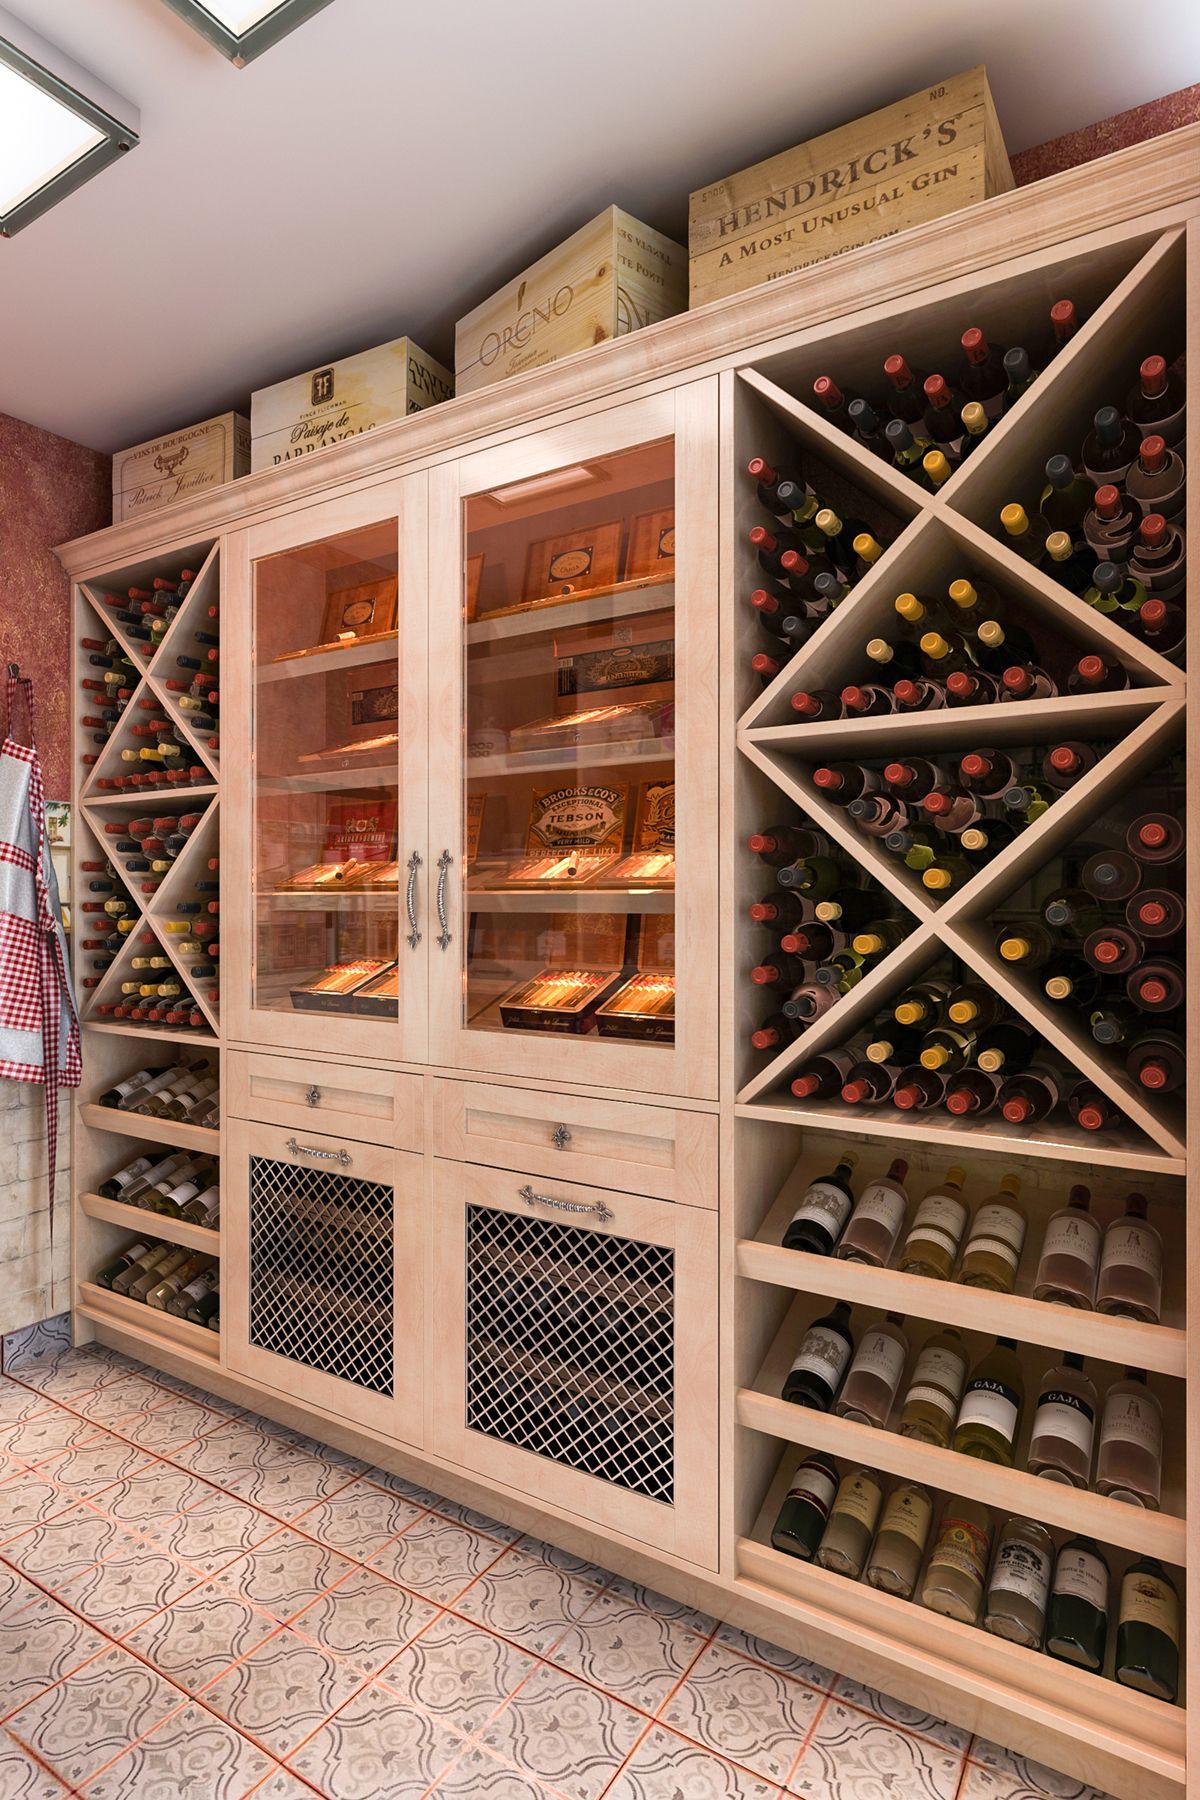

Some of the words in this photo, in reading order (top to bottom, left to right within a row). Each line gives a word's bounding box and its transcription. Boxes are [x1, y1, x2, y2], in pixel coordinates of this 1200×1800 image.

[717, 113, 964, 237] HENDRICK'S
[719, 251, 733, 268] A
[739, 228, 797, 260] MOST
[802, 187, 905, 234] UNUSUAL
[911, 163, 959, 192] GIN
[480, 285, 575, 367] ORENO
[133, 447, 150, 460] VINS
[151, 444, 161, 454] DE
[162, 426, 210, 450] BOURGOGNE
[290, 420, 334, 444] Paisaje
[335, 411, 350, 427] de
[550, 812, 604, 824] TEBSON
[552, 798, 605, 813] EXCEPTIONAL
[973, 1380, 1005, 1394] GAJA
[1047, 1393, 1081, 1409] GAJA
